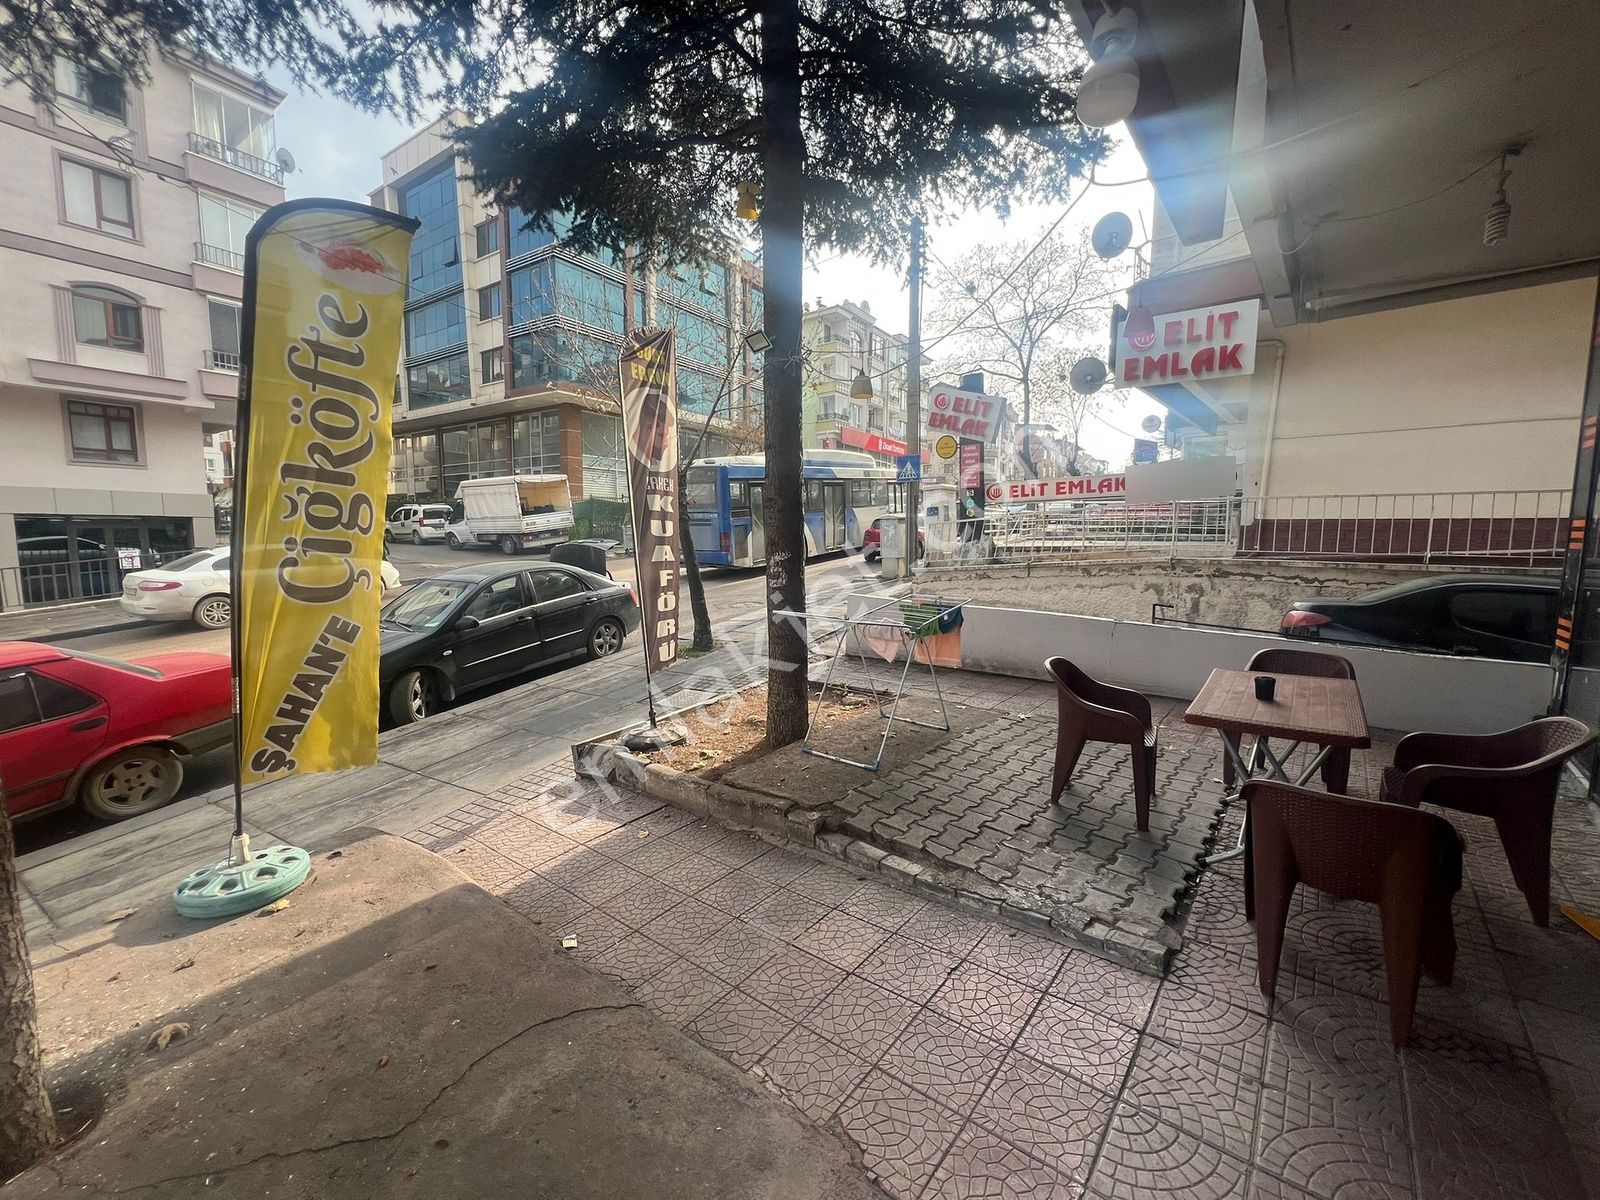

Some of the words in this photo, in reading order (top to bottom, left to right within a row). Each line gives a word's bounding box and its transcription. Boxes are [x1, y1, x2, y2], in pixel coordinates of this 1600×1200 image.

[1123, 342, 1244, 382] EMLAK
[1163, 310, 1240, 346] ELİT
[277, 294, 380, 604] Çiğköfte
[928, 411, 990, 438] EMLAK
[646, 494, 676, 662] KUAFÖRÜ
[251, 614, 363, 774] ŞAHAN'E
